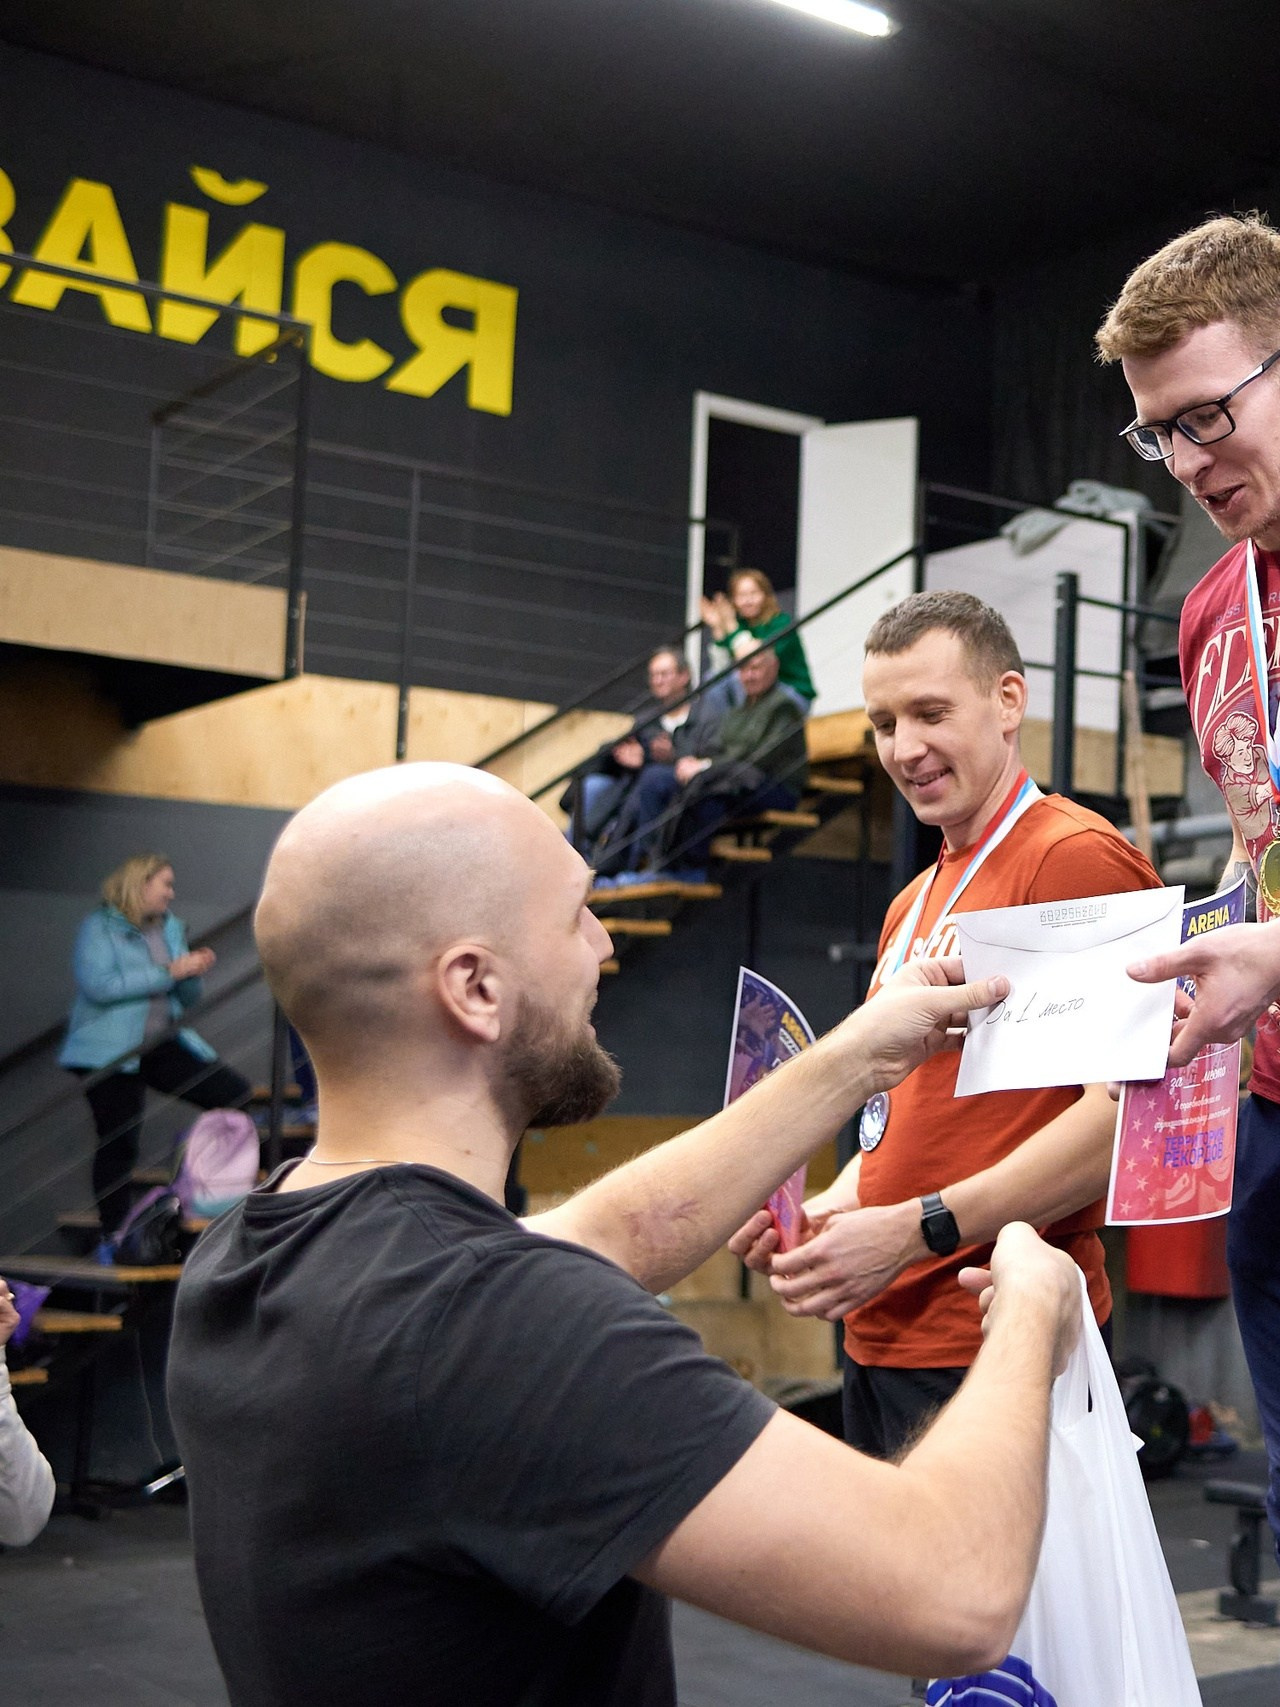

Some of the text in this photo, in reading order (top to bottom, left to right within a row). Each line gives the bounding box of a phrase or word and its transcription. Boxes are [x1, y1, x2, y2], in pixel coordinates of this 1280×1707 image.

[0, 164, 519, 417] АЙСЯ
[1186, 903, 1231, 937] ARENA
[1163, 1142, 1223, 1169] РЕКОРДОВ
